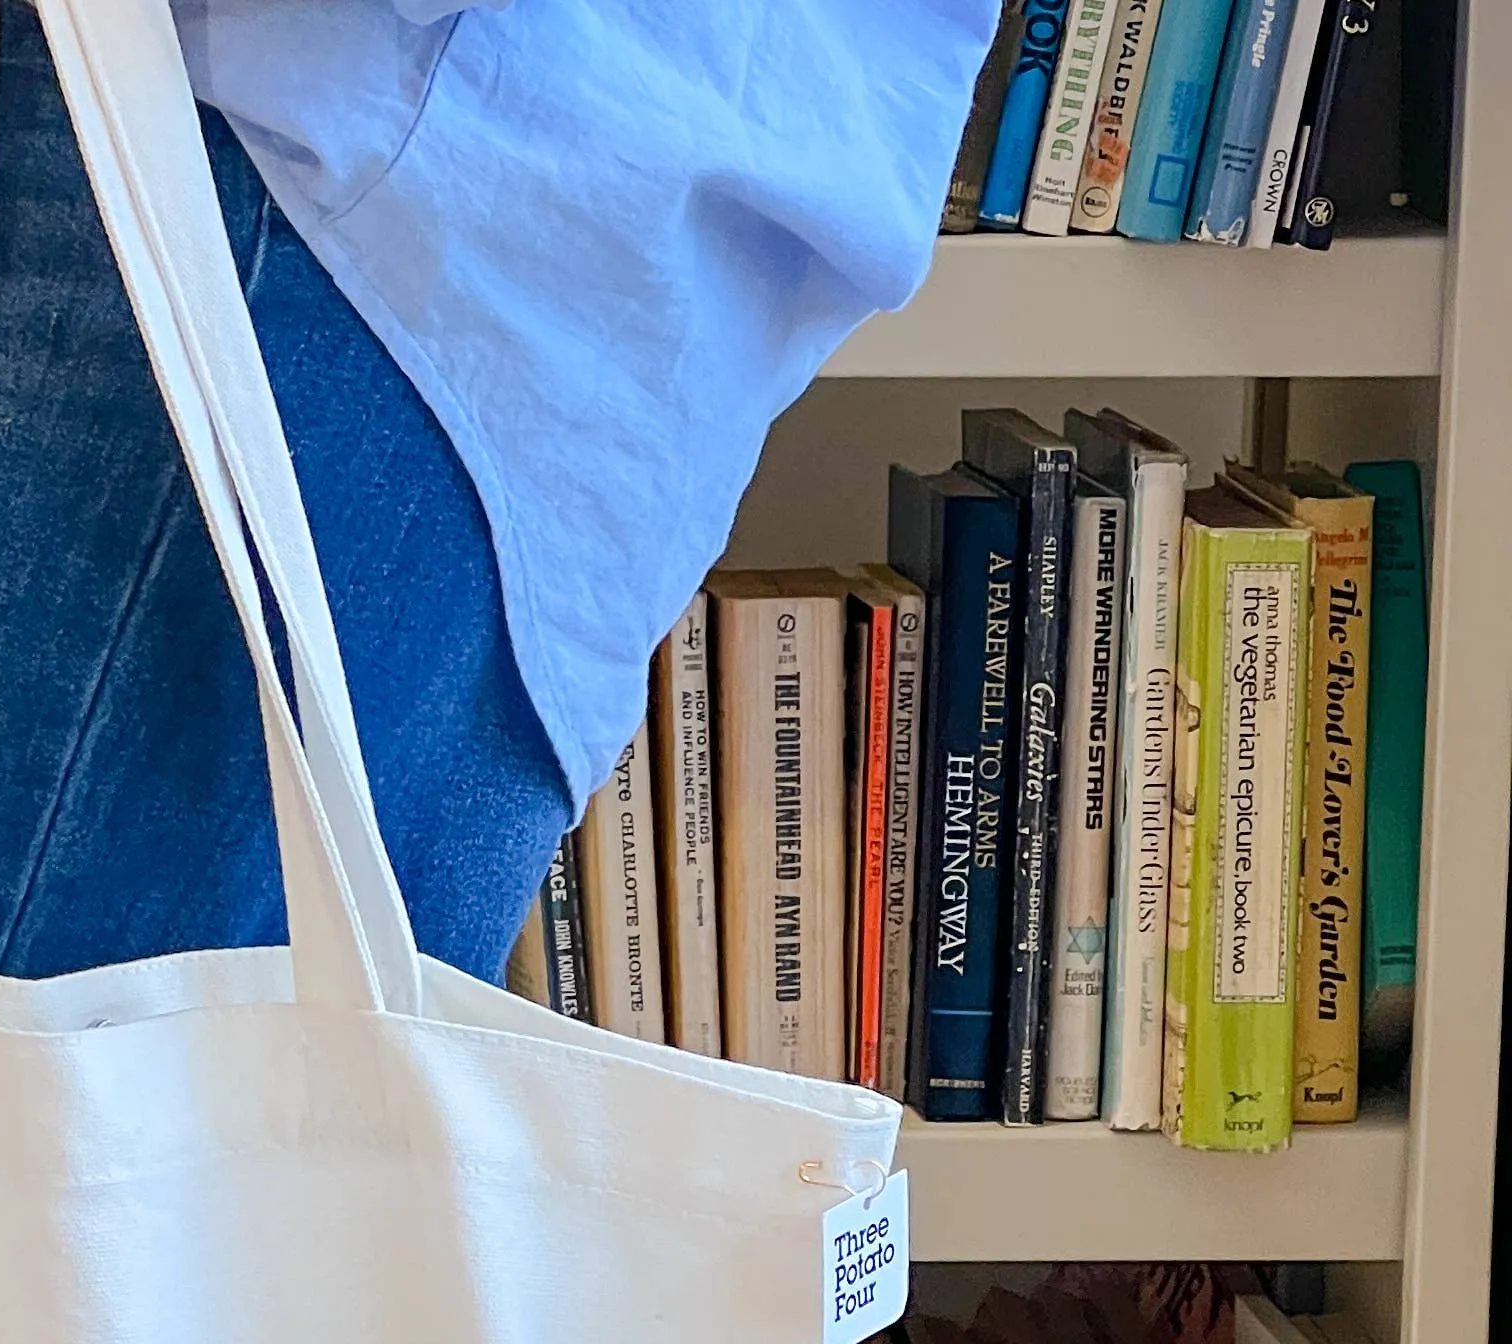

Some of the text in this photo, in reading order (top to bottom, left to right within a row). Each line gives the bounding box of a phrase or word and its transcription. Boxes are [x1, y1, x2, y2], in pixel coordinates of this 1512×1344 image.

[1263, 147, 1288, 213] CROWN
[1039, 535, 1058, 619] SHAPLEY
[1085, 508, 1118, 830] MORE WANDERING STARS
[1263, 585, 1282, 702] anna thomas
[774, 671, 801, 711] THE
[974, 551, 1013, 870] A FAREWELL TO ARMS
[1144, 667, 1171, 778] Gardens
[682, 690, 697, 866] AND INFLUENCE PEOPLE
[695, 689, 712, 845] HOW TO WIN FRIENDS
[1025, 681, 1058, 803] Galaxies
[1231, 586, 1267, 975] the vegetarian epicure, book two
[774, 716, 802, 880] FOUNTAINHEAD
[1140, 783, 1168, 854] Under
[1309, 578, 1363, 1022] The Food Lover's Garden
[937, 751, 976, 977] HEMINGWAY
[1026, 830, 1043, 953] THIRD EDITION
[1138, 856, 1164, 934] Glass
[774, 895, 802, 938] AYN
[554, 919, 579, 1017] JOHN KNOWLES
[774, 942, 802, 1002] RAND
[1018, 1048, 1032, 1113] HARVARD
[1224, 1117, 1265, 1134] knopf
[1303, 1086, 1345, 1105] Knopf
[834, 1216, 890, 1264] Three
[834, 1243, 896, 1294] Potato
[834, 1281, 877, 1324] Four
